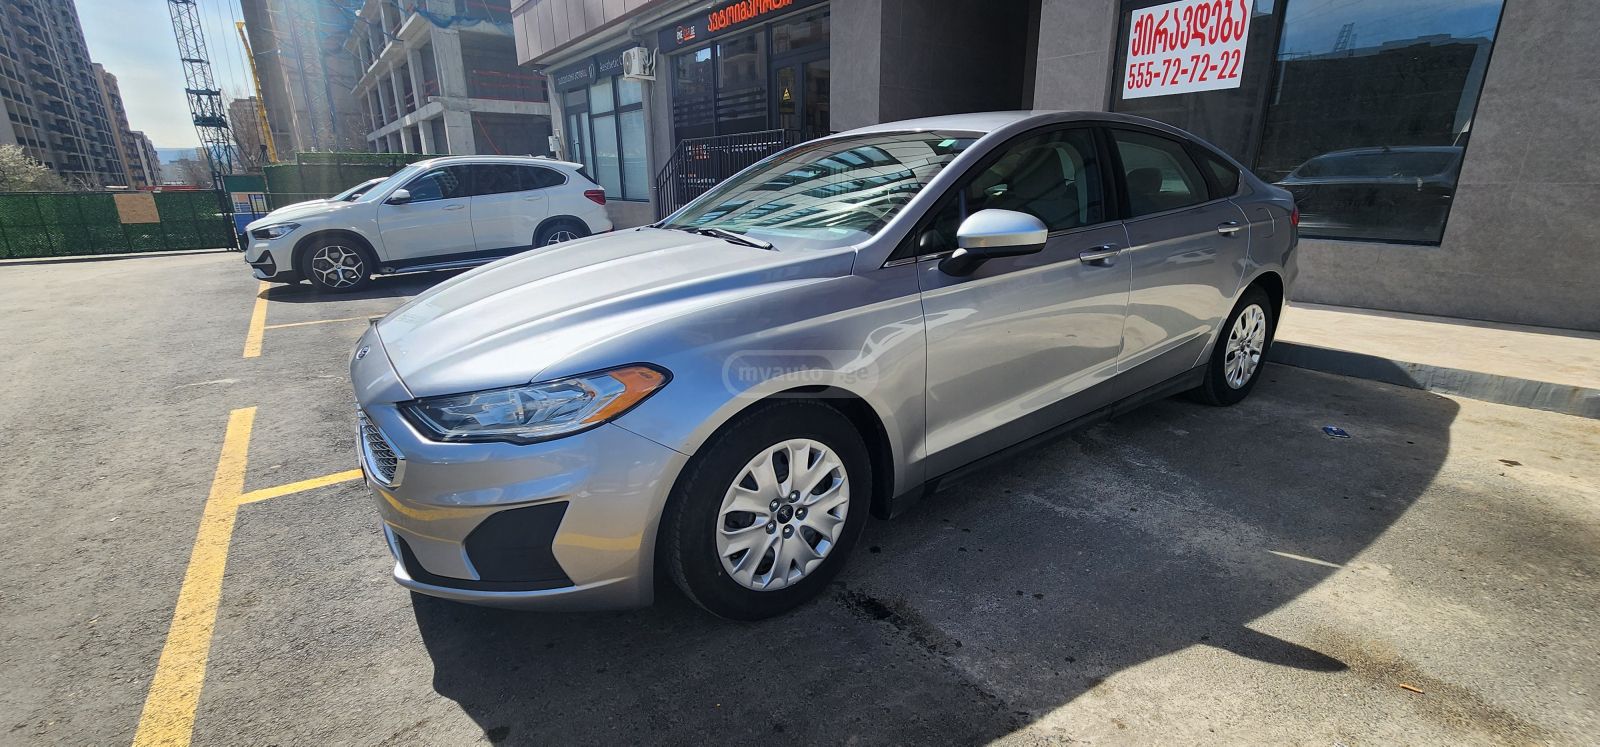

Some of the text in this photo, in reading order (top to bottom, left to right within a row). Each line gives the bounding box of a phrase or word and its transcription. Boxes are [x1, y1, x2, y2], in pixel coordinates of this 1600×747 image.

[708, 0, 793, 32] ავტოიმპორ
[1131, 0, 1247, 57] ქირავდება
[1127, 49, 1241, 90] 555-72-72-22
